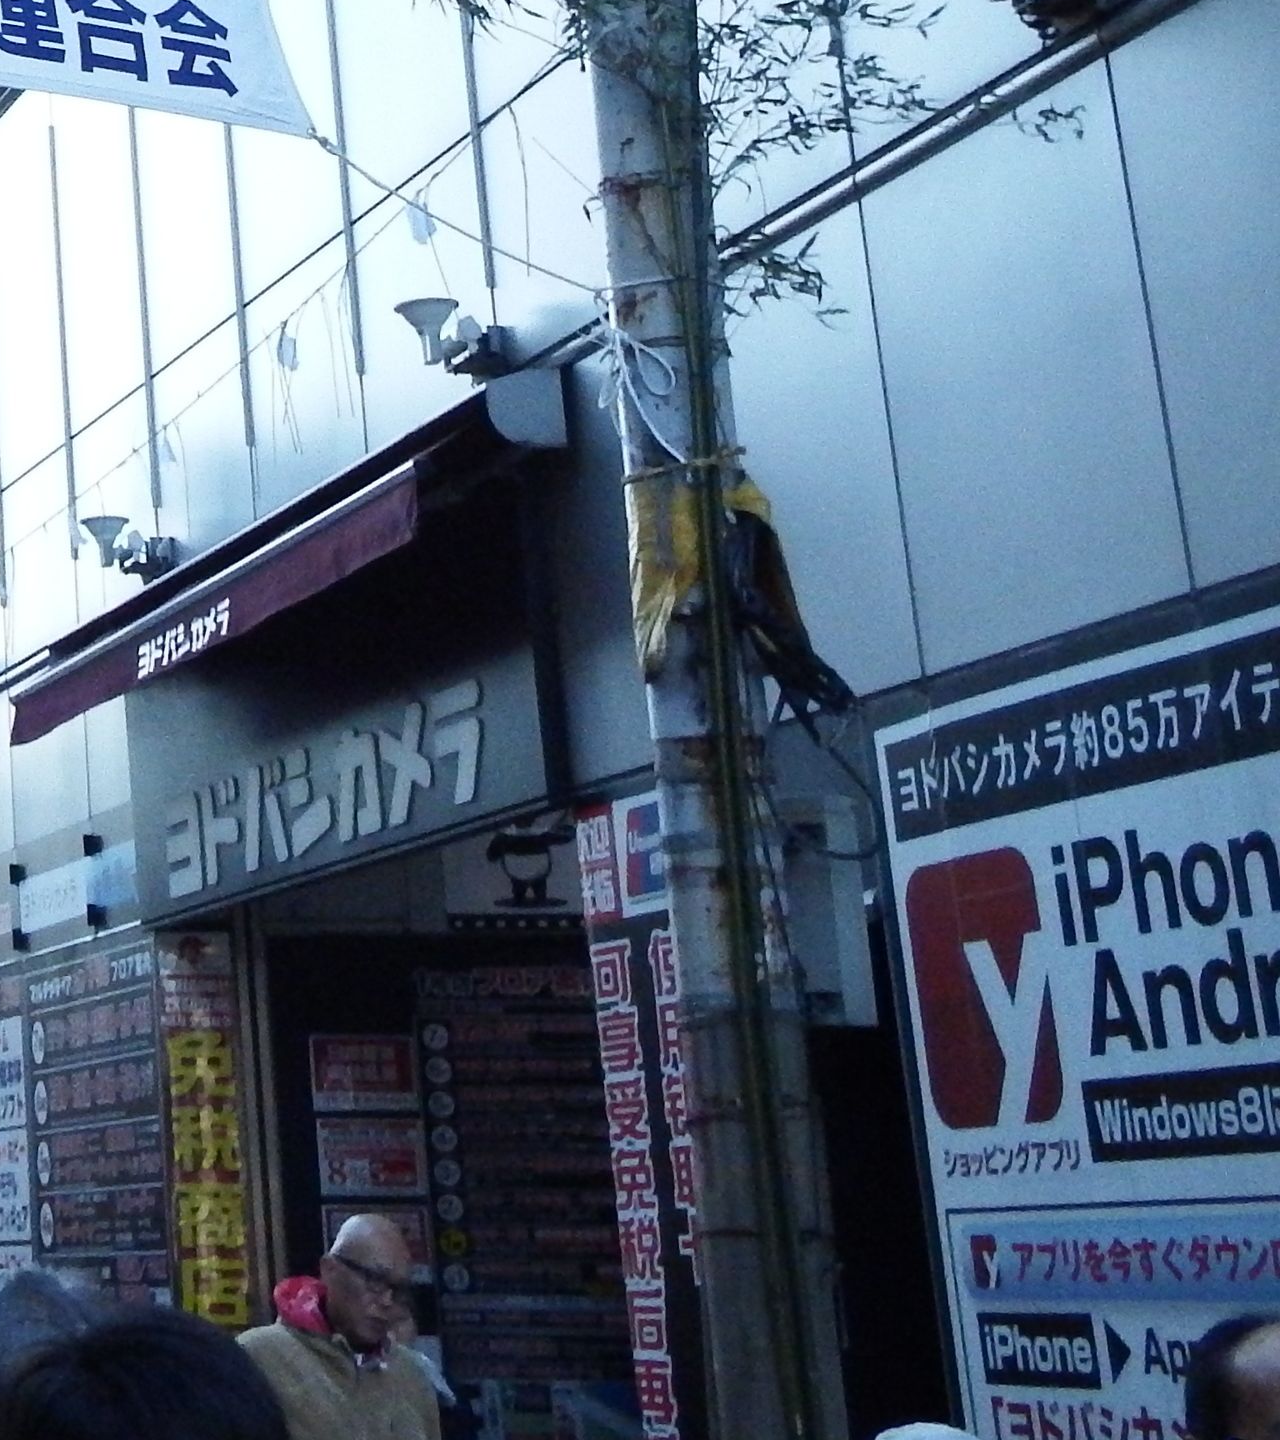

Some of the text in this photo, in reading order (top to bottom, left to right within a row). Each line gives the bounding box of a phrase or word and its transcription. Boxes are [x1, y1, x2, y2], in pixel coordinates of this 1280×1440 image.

[136, 597, 231, 679] ヨドバシカメラ
[164, 676, 486, 901] ヨドバシカメラ
[1050, 828, 1280, 947] iPhon
[589, 938, 680, 1440] 可享受免税后再
[943, 1138, 1081, 1178] ショッピングアプリ
[984, 1323, 1093, 1375] iPhone
[1144, 1326, 1191, 1384] Ap
